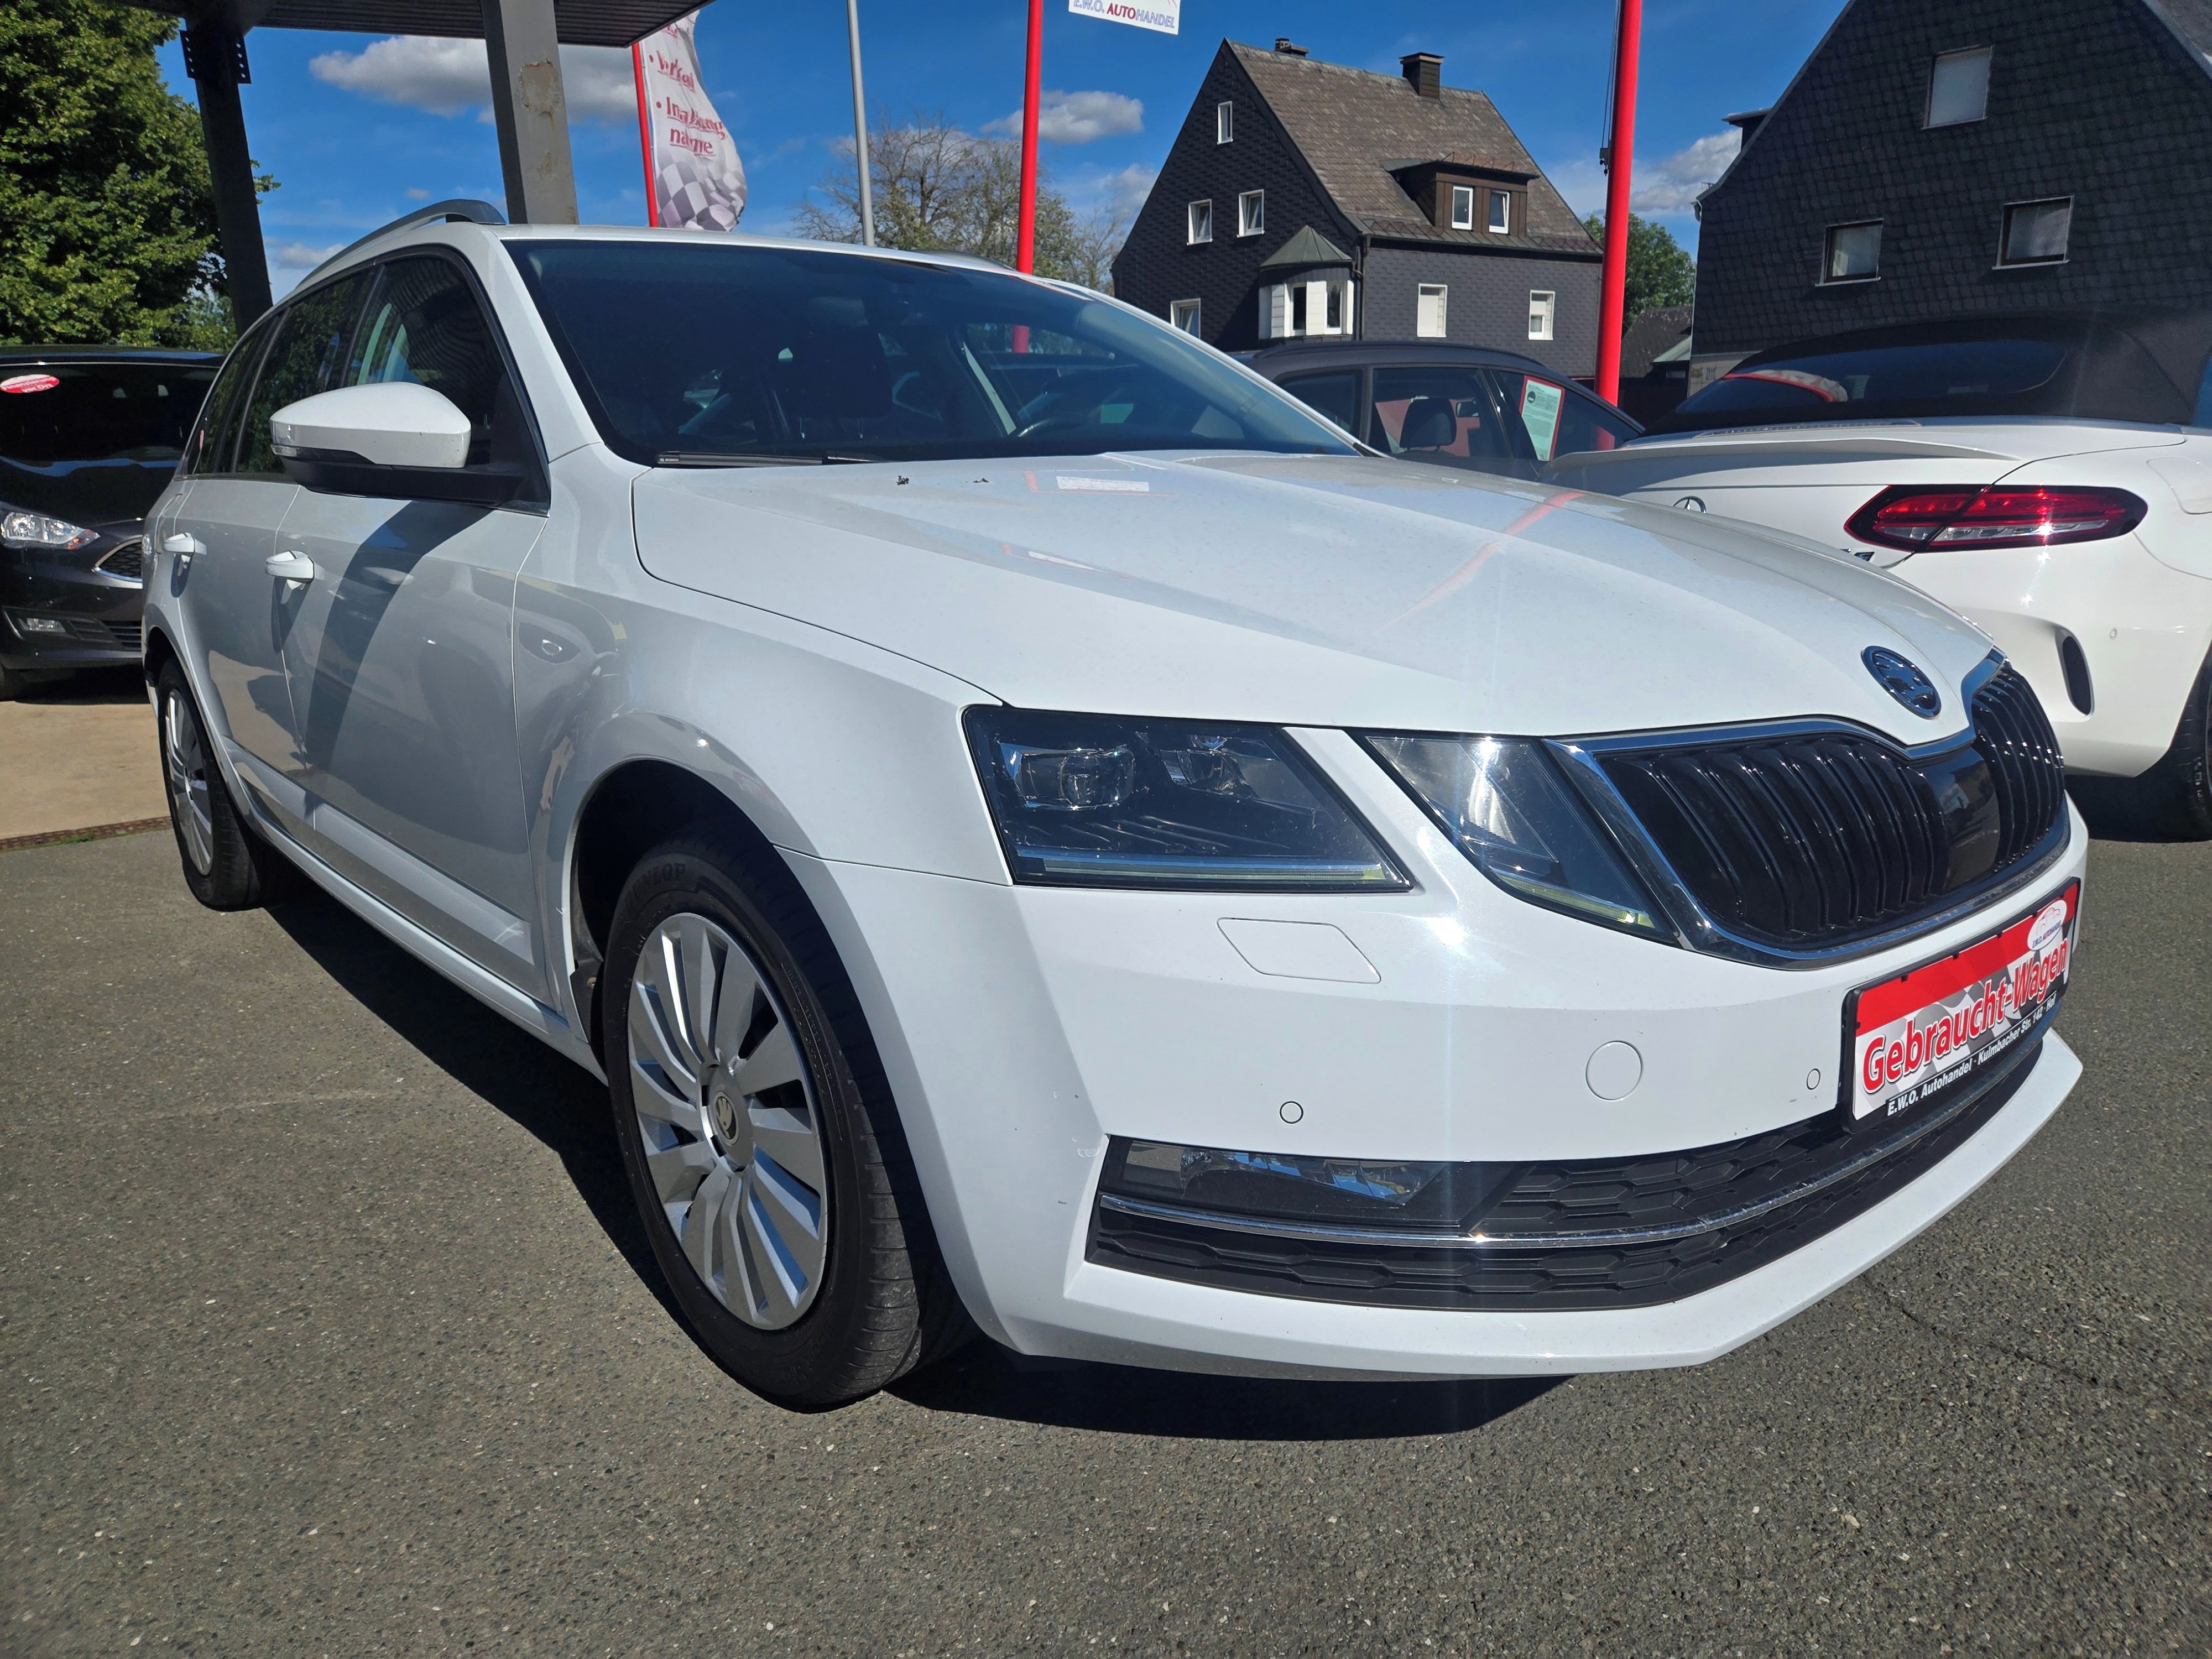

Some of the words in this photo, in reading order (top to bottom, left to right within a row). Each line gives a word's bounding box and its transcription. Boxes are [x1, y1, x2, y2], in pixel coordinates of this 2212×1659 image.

[1107, 3, 1175, 28] AUTOHANDEL
[1863, 938, 2067, 1093] Gebraucht-Wagen
[1887, 1089, 1919, 1117] E.W.O.
[1920, 1057, 1973, 1099] Autohandel
[1978, 1027, 2021, 1065] Kulmbacher
[2021, 1019, 2032, 1034] Str.
[2033, 1005, 2043, 1024] 142
[2046, 993, 2057, 1012] Hof
